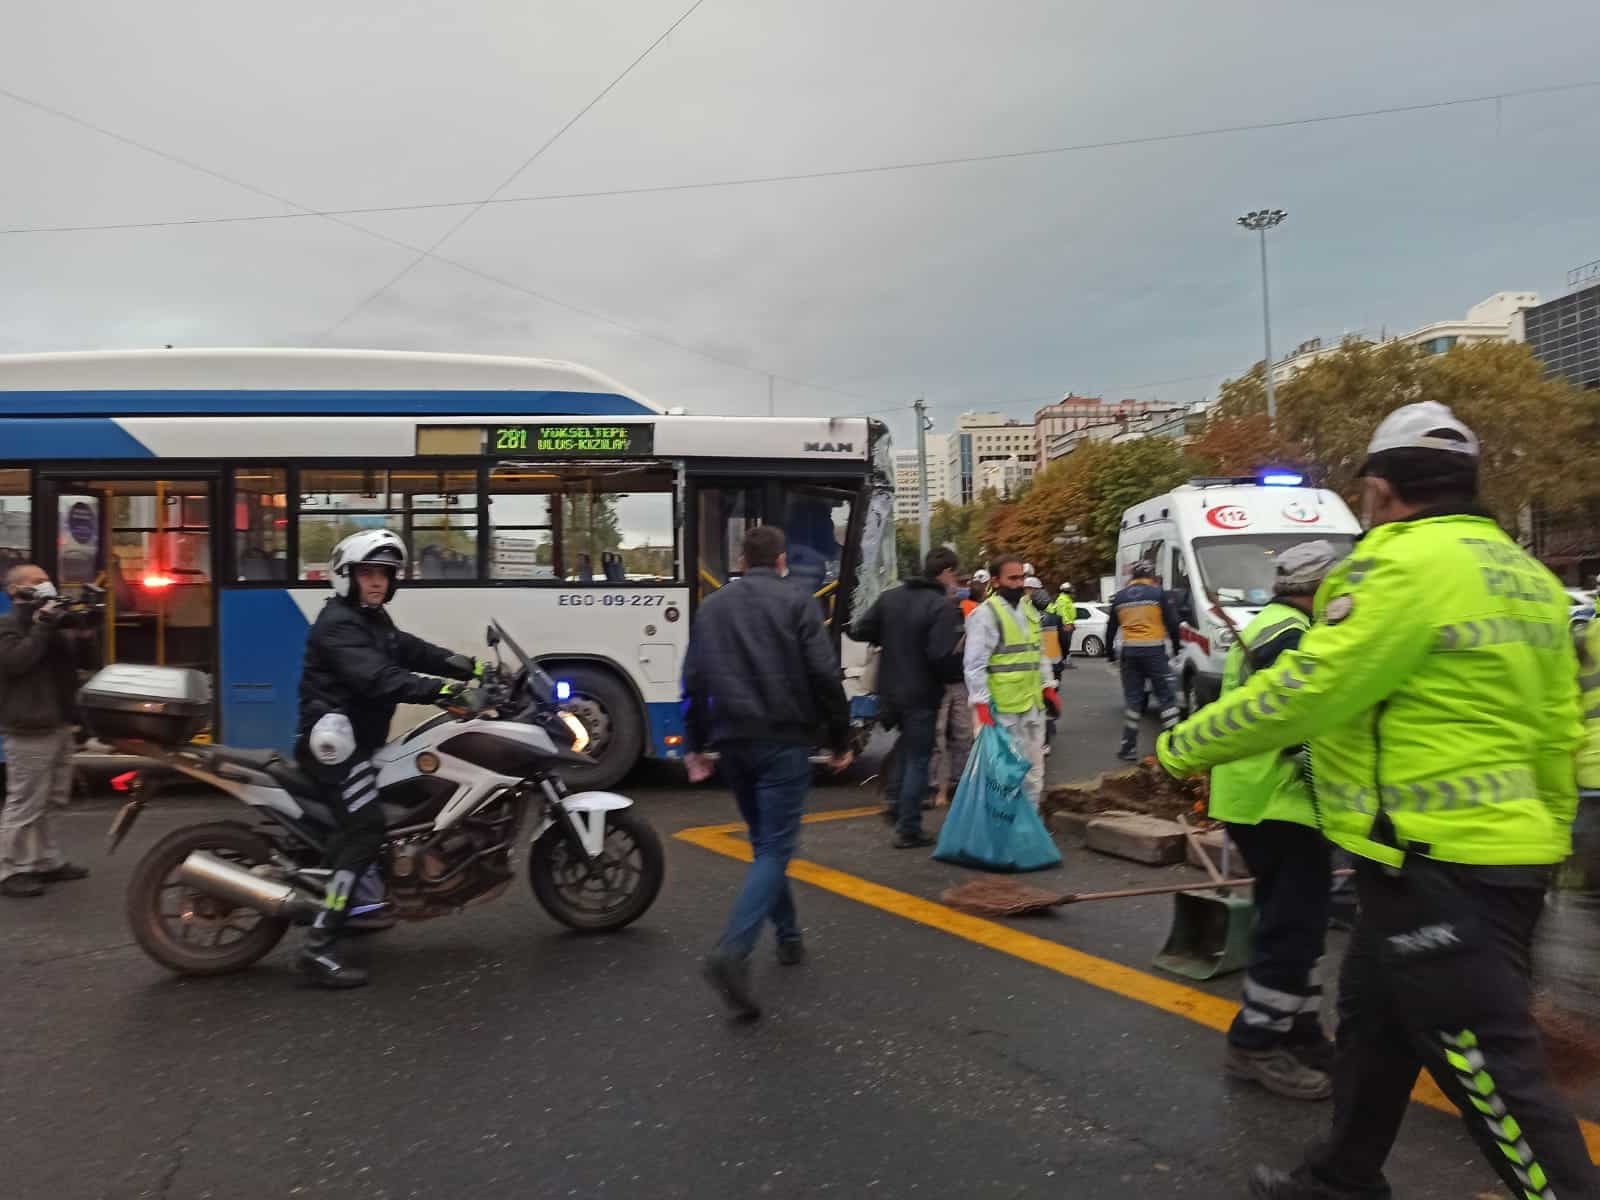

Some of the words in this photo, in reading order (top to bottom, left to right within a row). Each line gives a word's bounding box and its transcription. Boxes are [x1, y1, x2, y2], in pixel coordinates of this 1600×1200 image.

[496, 429, 527, 449] 281
[803, 442, 853, 453] MAN
[1218, 510, 1249, 522] 112
[557, 594, 665, 606] EGO-09-227
